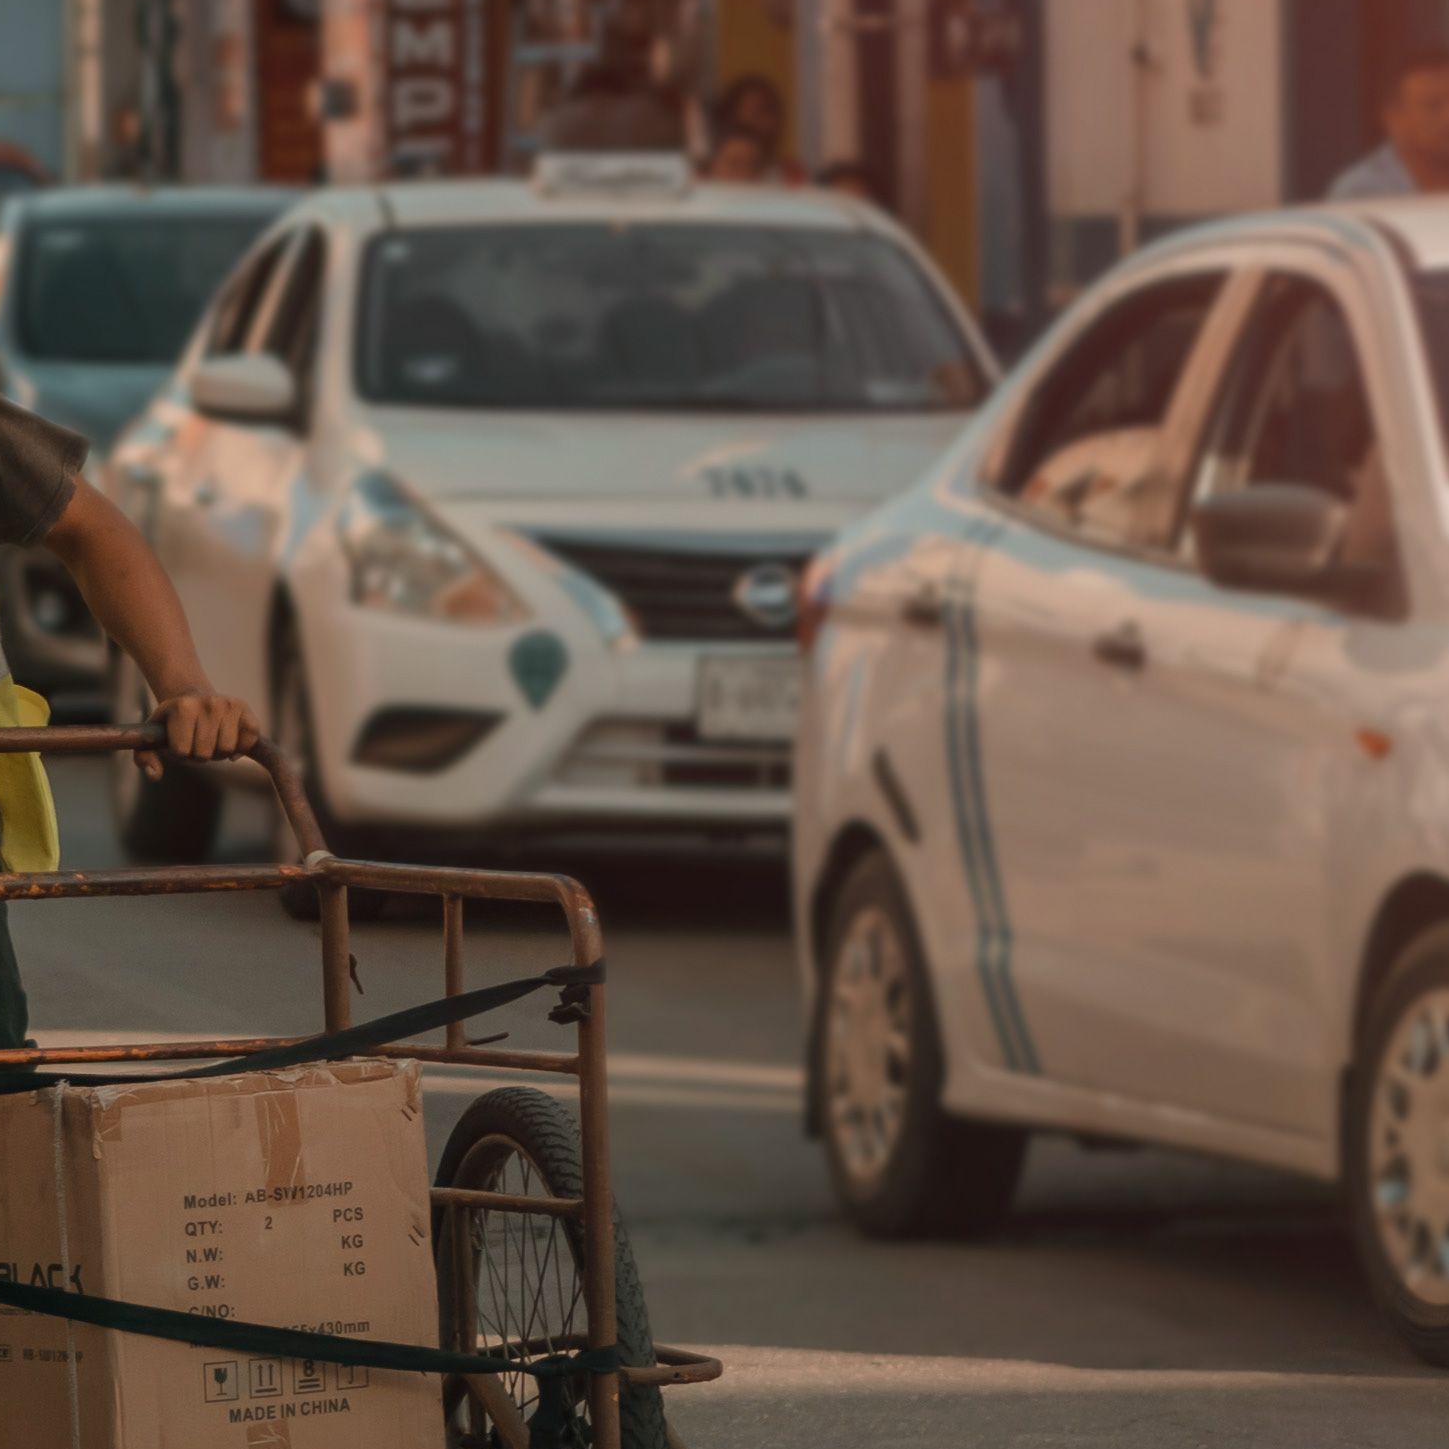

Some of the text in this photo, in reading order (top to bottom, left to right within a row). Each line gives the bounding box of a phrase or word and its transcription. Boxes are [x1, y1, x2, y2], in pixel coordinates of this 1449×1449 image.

[184, 1181, 353, 1209] Model: AB-SW1204HP
[185, 1207, 364, 1236] QTY: 2 PCS
[186, 1234, 364, 1263] N.W: KG
[187, 1261, 366, 1291] G.W: KG
[229, 1398, 350, 1423] MADE IN CHINA
